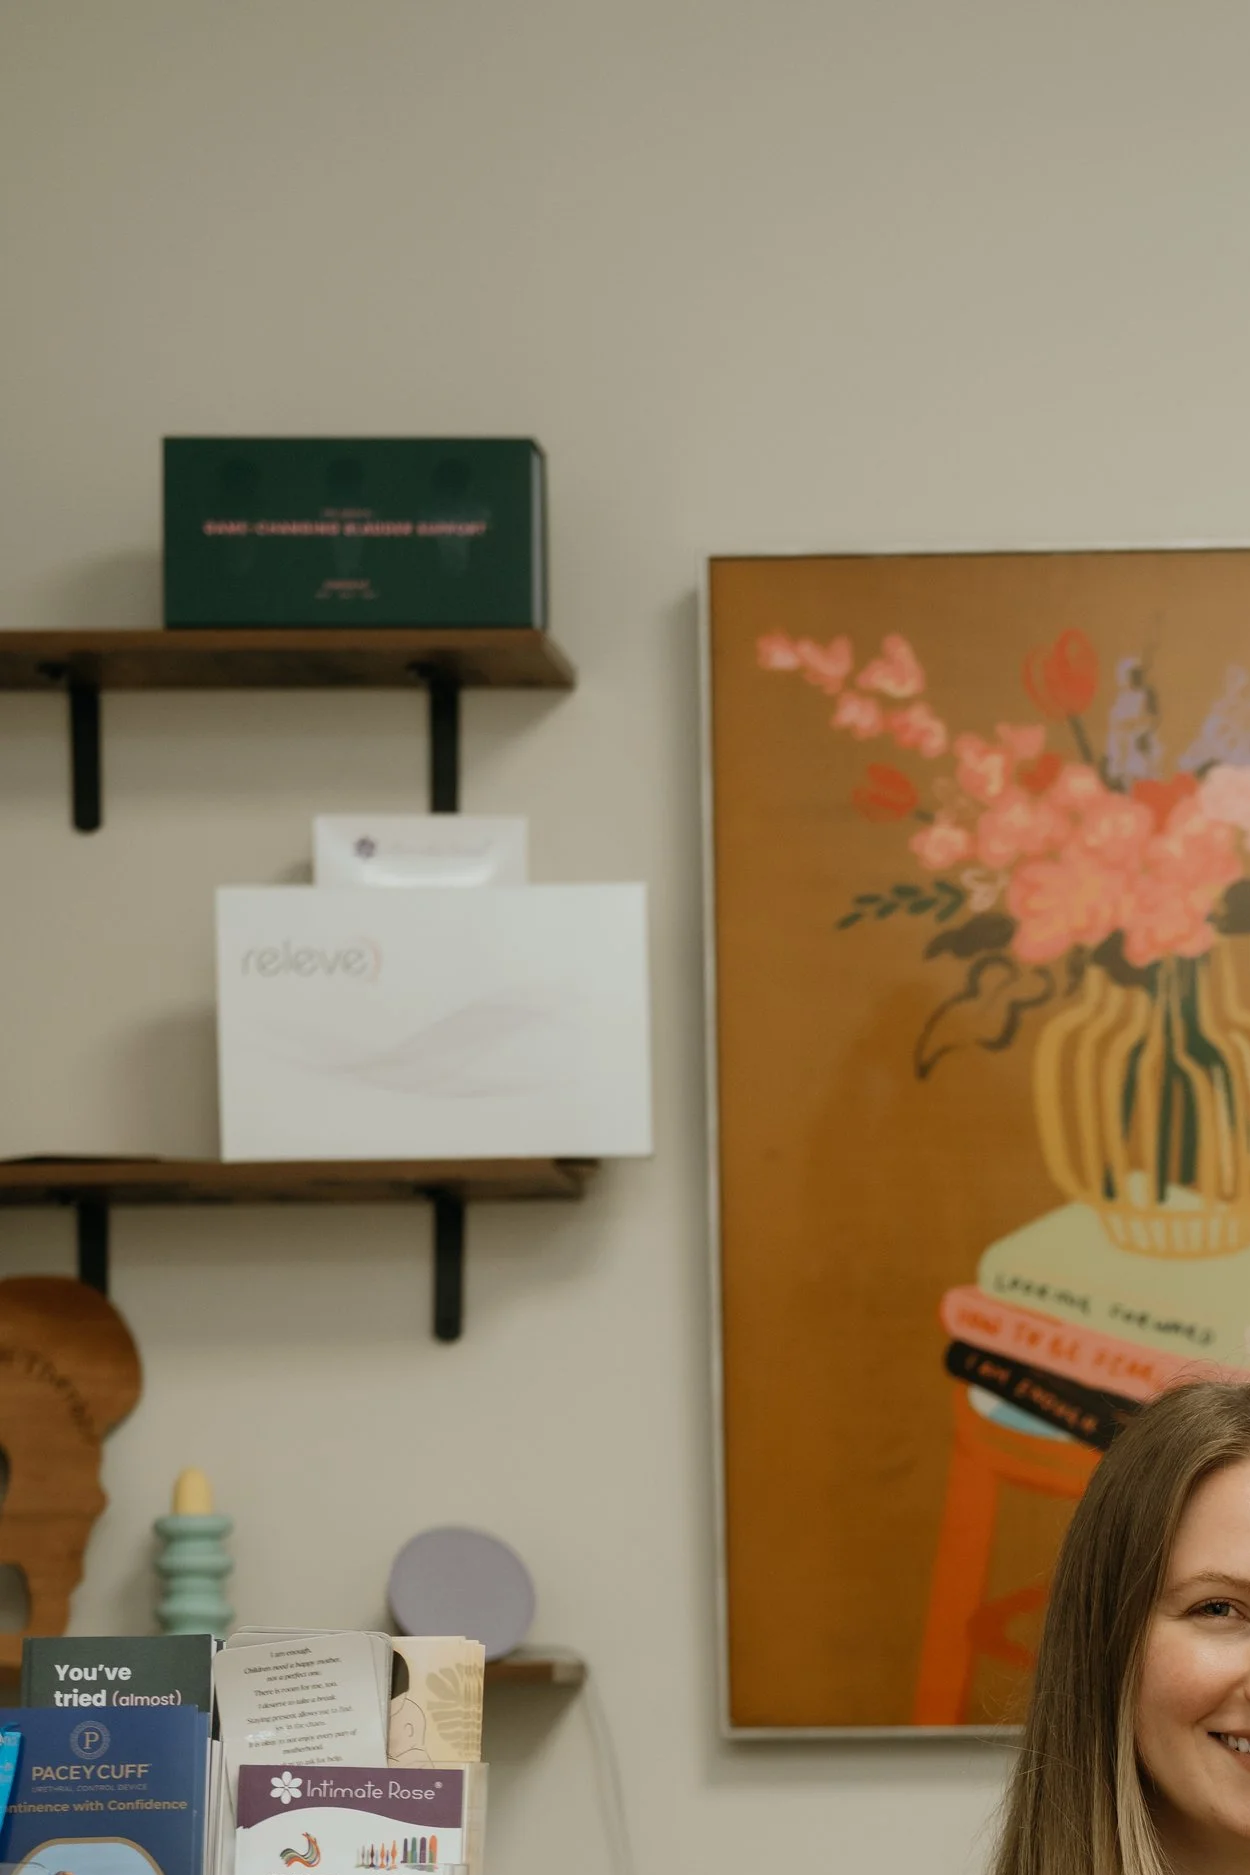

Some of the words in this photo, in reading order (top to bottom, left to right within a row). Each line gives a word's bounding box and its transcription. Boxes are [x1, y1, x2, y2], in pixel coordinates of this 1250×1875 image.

[54, 1664, 132, 1682] You've
[54, 1688, 107, 1708] tried
[112, 1689, 183, 1708] (almost)
[306, 1779, 384, 1799] Intimate
[7, 1801, 69, 1814] ntinence
[73, 1800, 104, 1812] with
[107, 1798, 188, 1812] Confidence
